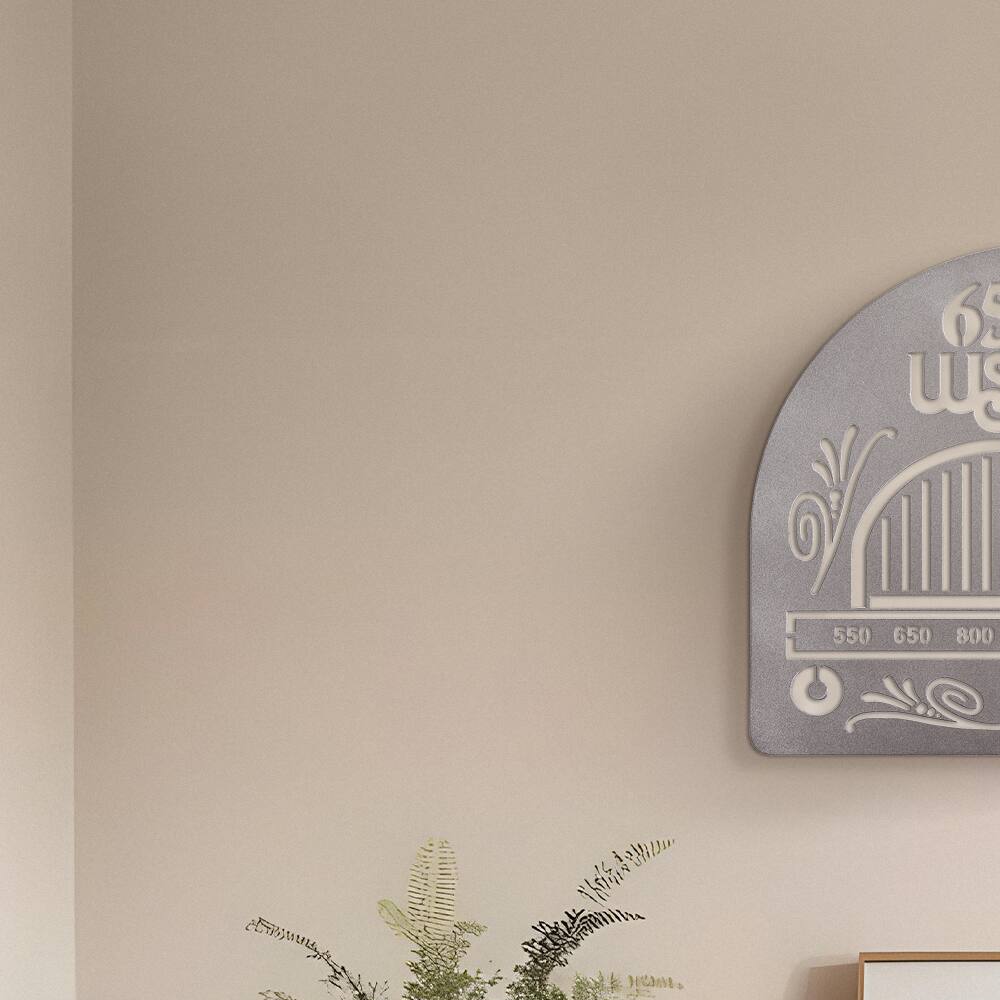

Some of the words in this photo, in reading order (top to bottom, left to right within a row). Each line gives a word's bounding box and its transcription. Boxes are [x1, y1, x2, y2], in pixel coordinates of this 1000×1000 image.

[833, 625, 872, 645] 550
[893, 625, 932, 645] 650
[956, 625, 994, 645] 800
